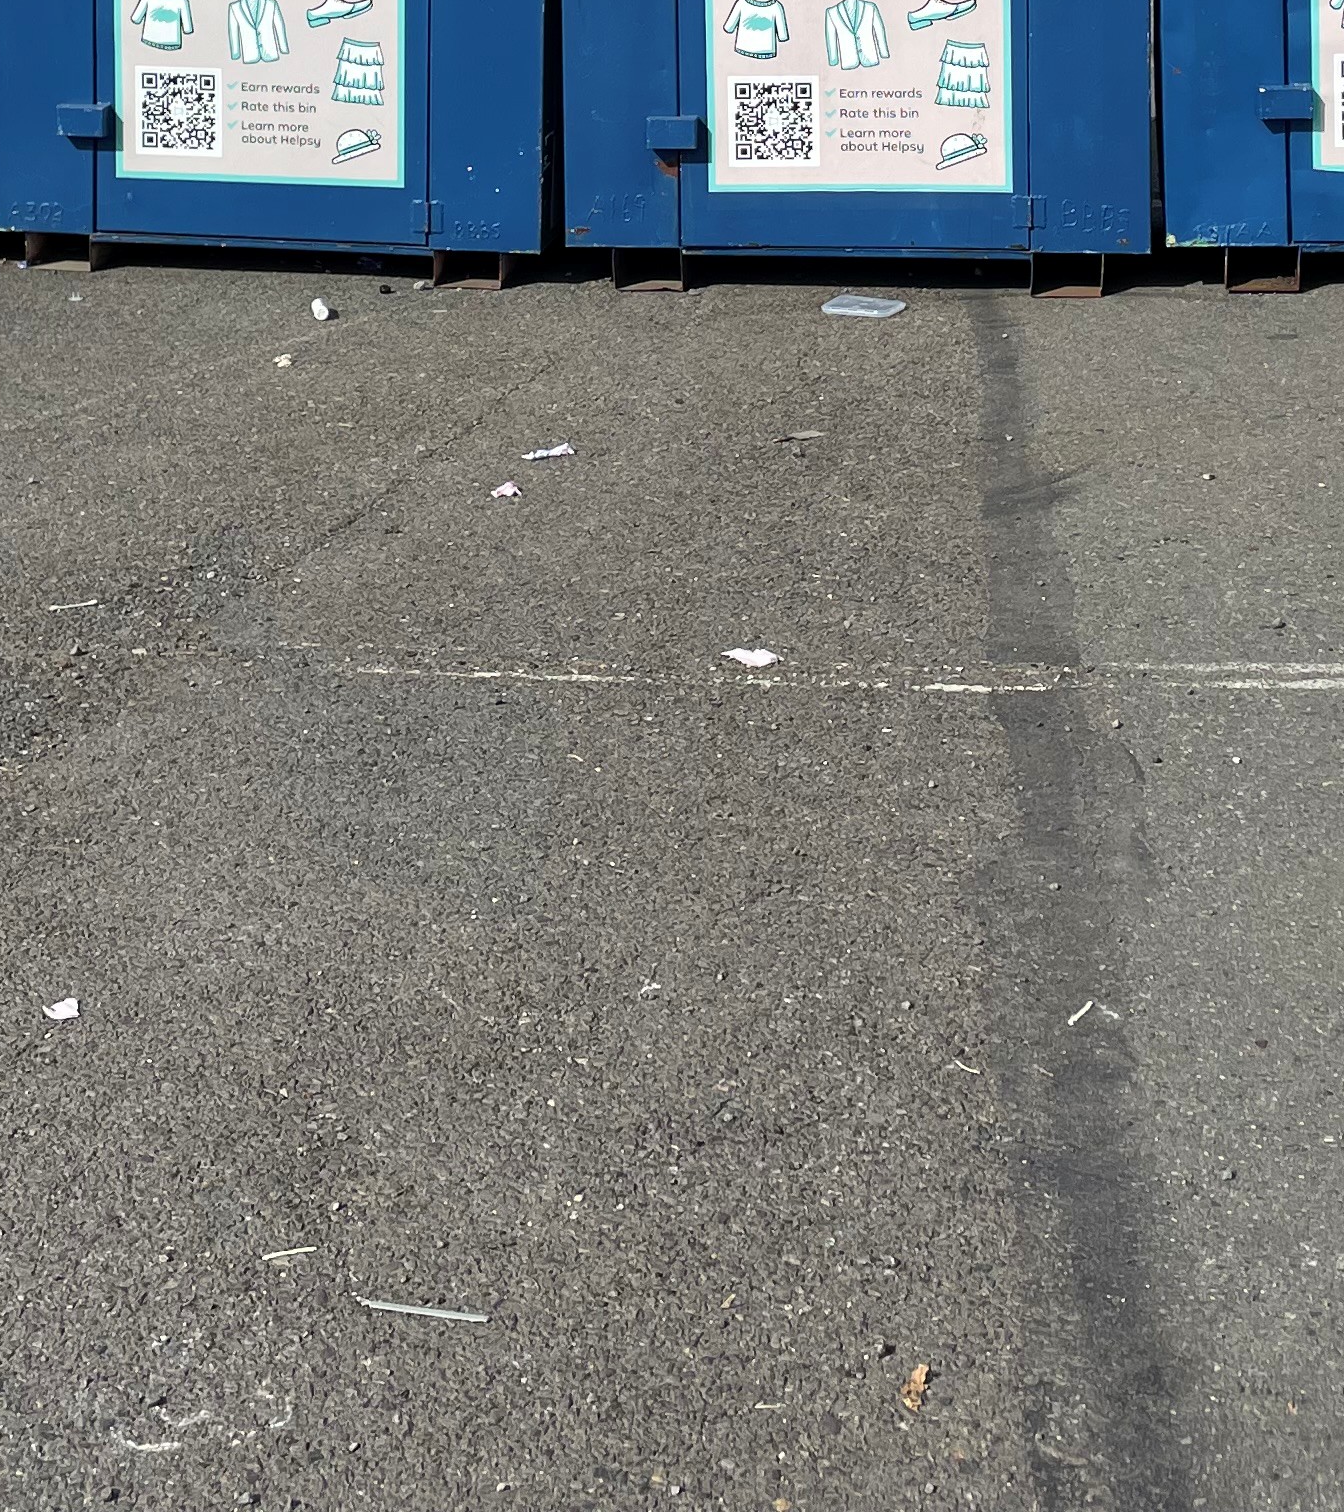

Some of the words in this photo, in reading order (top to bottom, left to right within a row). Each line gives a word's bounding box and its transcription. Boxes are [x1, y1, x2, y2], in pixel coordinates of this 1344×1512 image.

[241, 82, 269, 93] Earn
[271, 84, 320, 95] rewards
[839, 88, 868, 99] Earn
[871, 88, 923, 99] rewards
[241, 102, 269, 113] Rate
[273, 102, 295, 113] this
[298, 103, 316, 113] bin
[839, 108, 869, 119] Rate
[872, 108, 896, 119] this
[900, 108, 919, 119] bin
[242, 121, 275, 132] Learn
[278, 123, 309, 133] more
[839, 128, 876, 139] Learn
[878, 130, 911, 139] more
[242, 134, 277, 145] about
[280, 135, 321, 148] Helpsy
[840, 141, 878, 152] about
[881, 141, 925, 154] Helpsy
